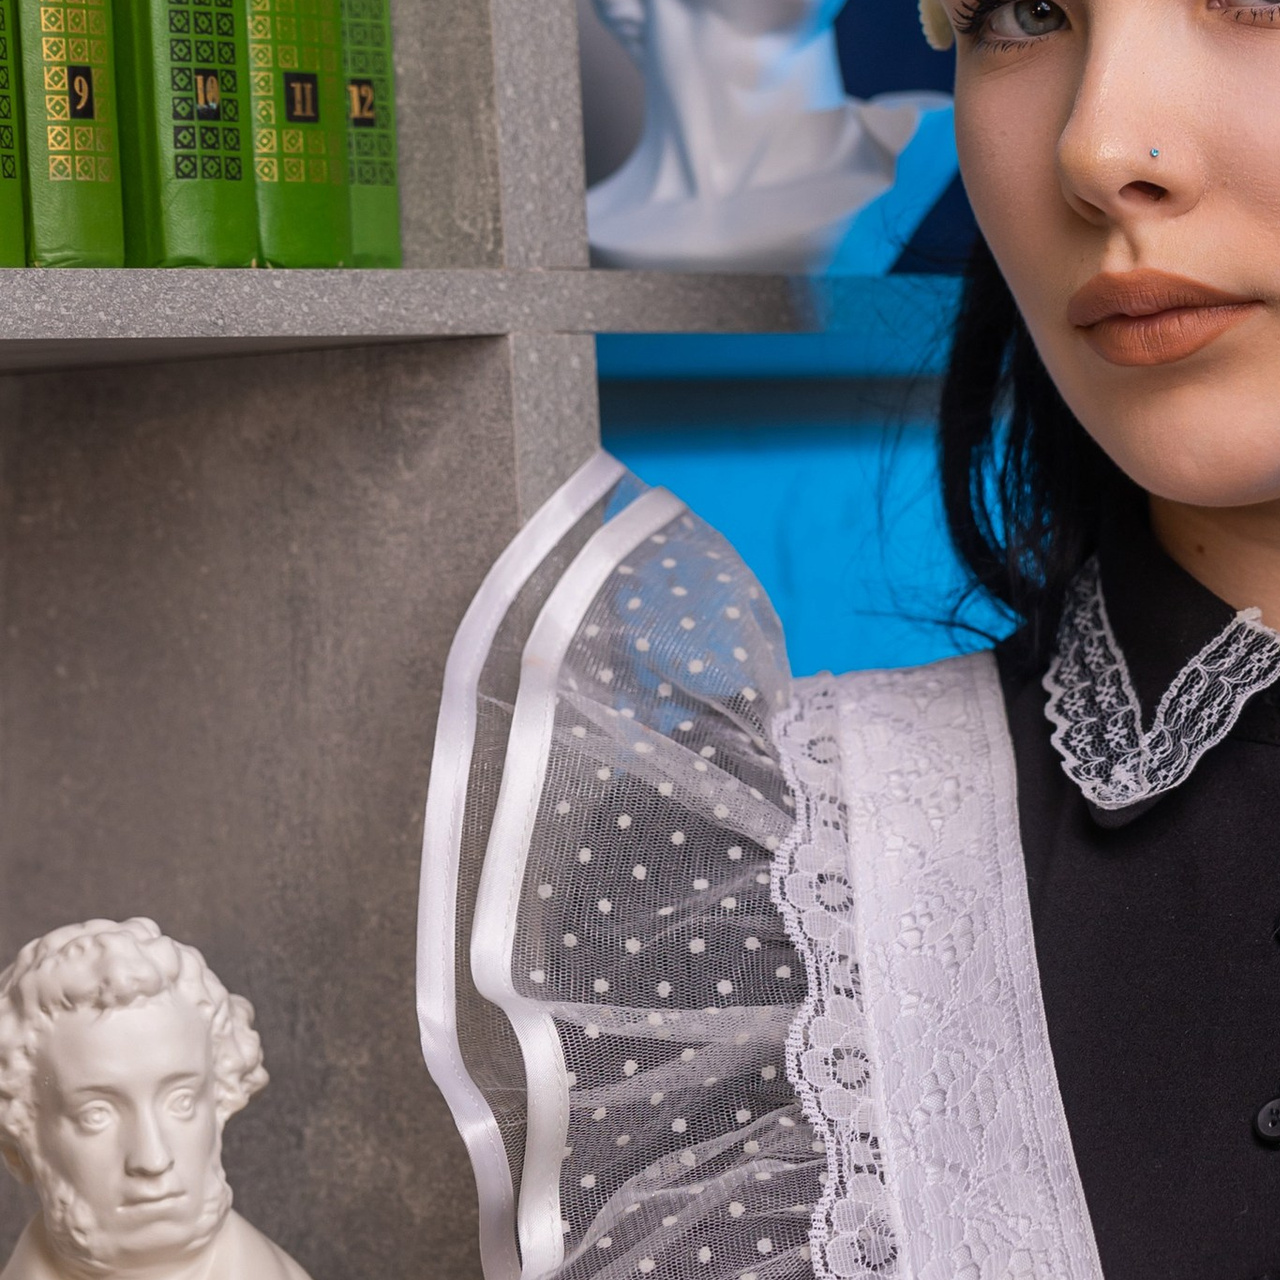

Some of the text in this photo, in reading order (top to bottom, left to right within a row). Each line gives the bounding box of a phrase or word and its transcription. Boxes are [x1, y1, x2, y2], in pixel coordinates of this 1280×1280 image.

[74, 75, 89, 110] 9
[195, 75, 221, 109] 10
[289, 81, 315, 117] 11
[348, 84, 375, 119] 12
